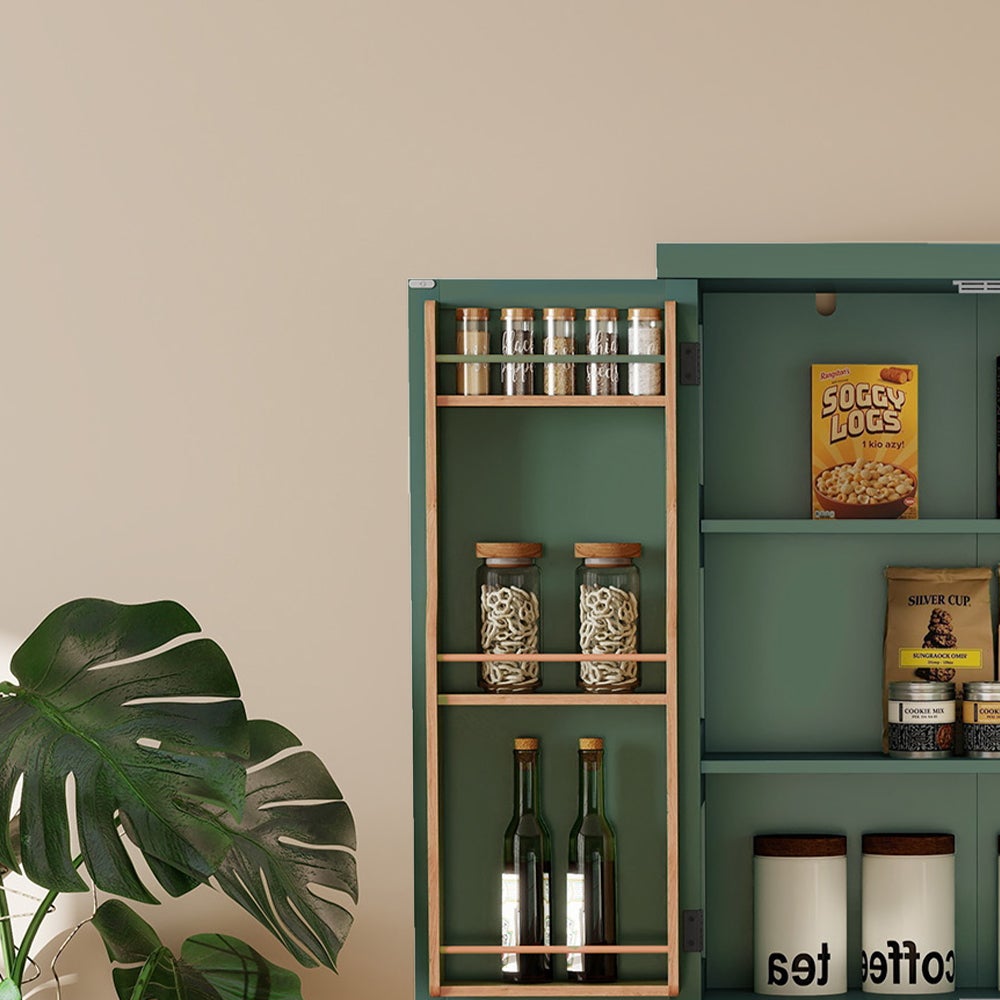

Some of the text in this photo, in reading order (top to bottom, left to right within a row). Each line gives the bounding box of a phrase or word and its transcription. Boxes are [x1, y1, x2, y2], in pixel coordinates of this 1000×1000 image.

[822, 383, 905, 417] SOGGY
[830, 409, 902, 443] LOGS
[908, 594, 970, 606] SILVER CUP
